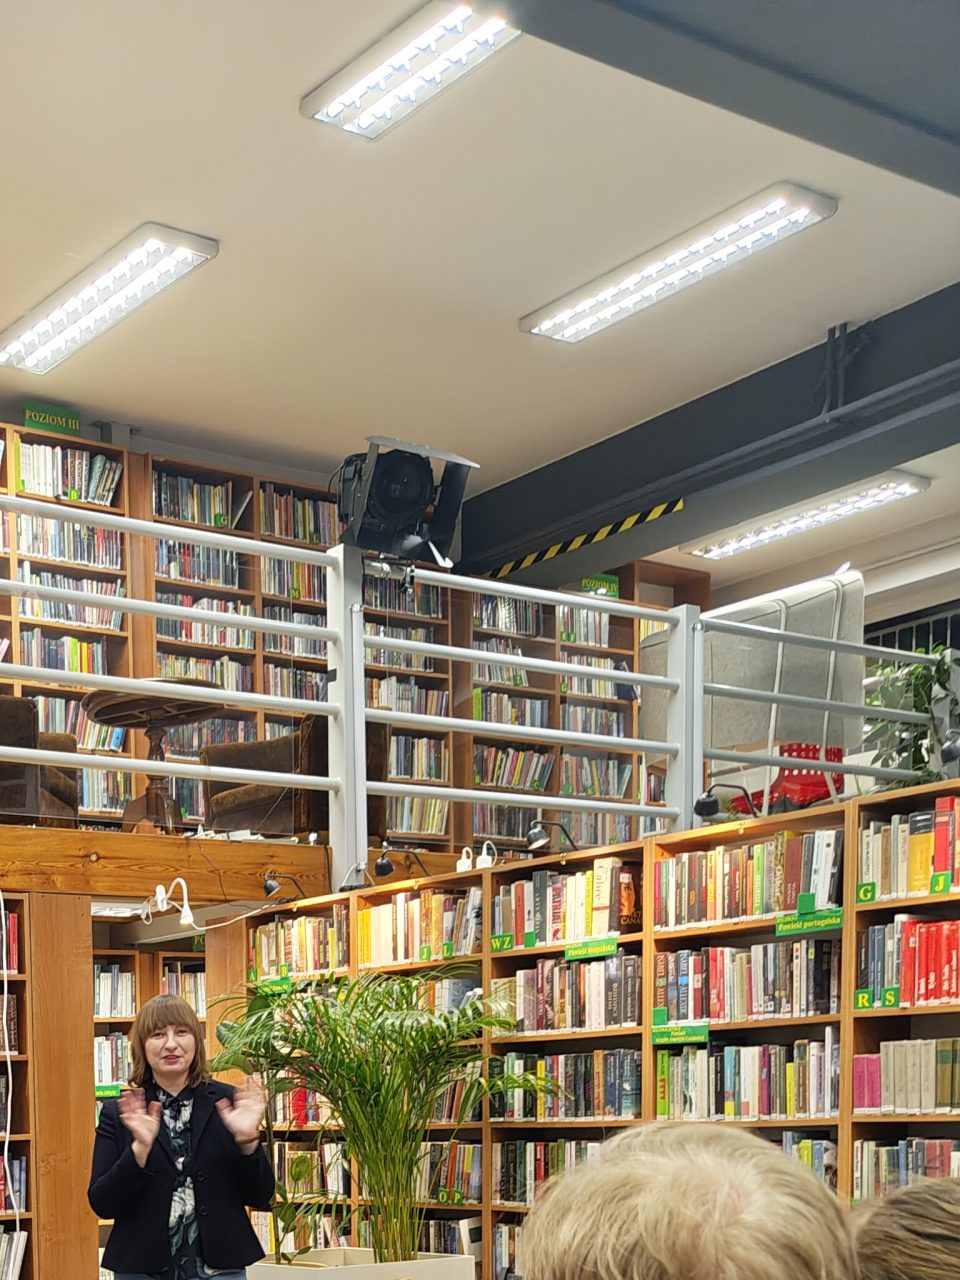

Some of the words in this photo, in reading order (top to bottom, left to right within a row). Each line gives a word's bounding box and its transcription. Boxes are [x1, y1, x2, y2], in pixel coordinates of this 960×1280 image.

[25, 408, 67, 430] POZIOM
[68, 419, 80, 432] III
[935, 876, 945, 892] J
[859, 885, 873, 900] G
[803, 917, 841, 929] portugalska
[491, 938, 502, 950] W
[503, 936, 512, 948] Z
[656, 987, 665, 1008] ALLEN
[857, 993, 870, 1007] R
[885, 990, 896, 1006] S
[439, 1191, 447, 1203] O
[454, 1192, 461, 1203] P
